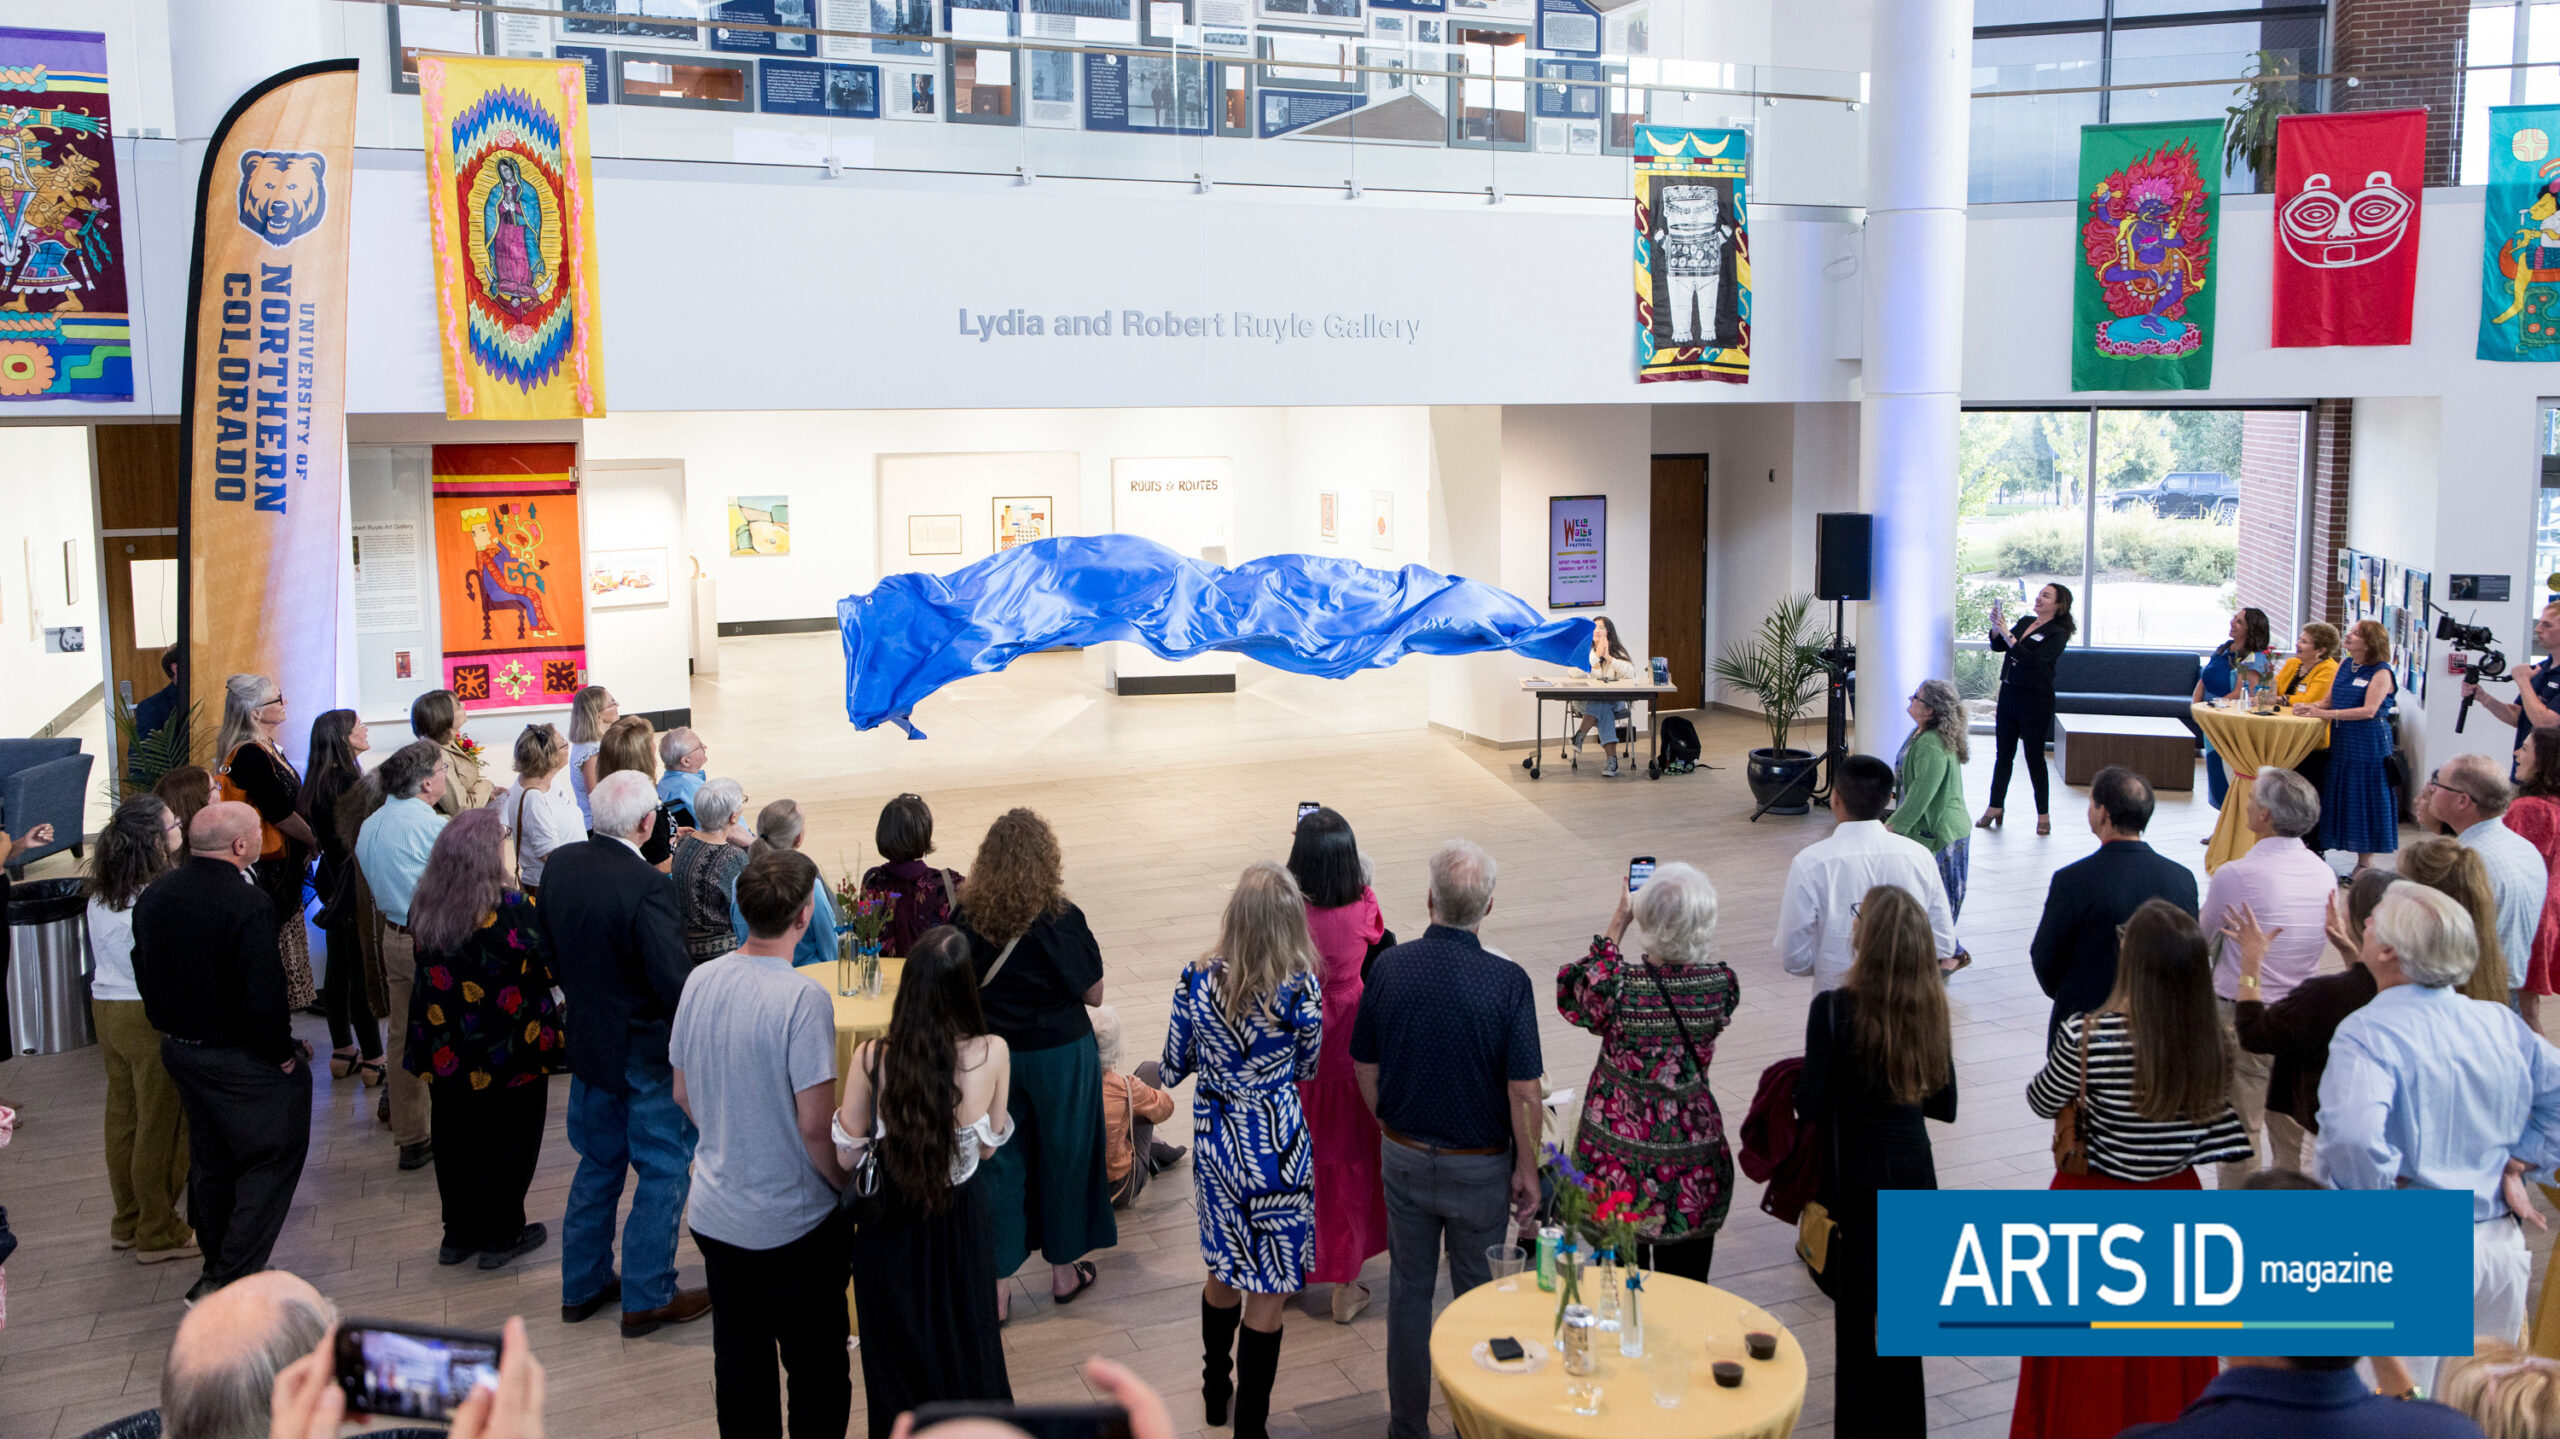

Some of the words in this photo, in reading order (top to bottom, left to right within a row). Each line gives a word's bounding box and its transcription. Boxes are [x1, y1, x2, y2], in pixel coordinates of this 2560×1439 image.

[959, 308, 1045, 342] Lydia
[1054, 310, 1113, 337] and
[1122, 310, 1225, 338] Robert
[1234, 311, 1316, 344] Ruyle
[1324, 312, 1421, 344] Gallery
[214, 272, 252, 502] COLORADO
[254, 262, 293, 515] NORTHERN
[297, 303, 315, 446] UNIVERSITY
[296, 453, 309, 481] OF
[1130, 480, 1162, 492] ROOTS
[1178, 480, 1218, 492] ROUTES
